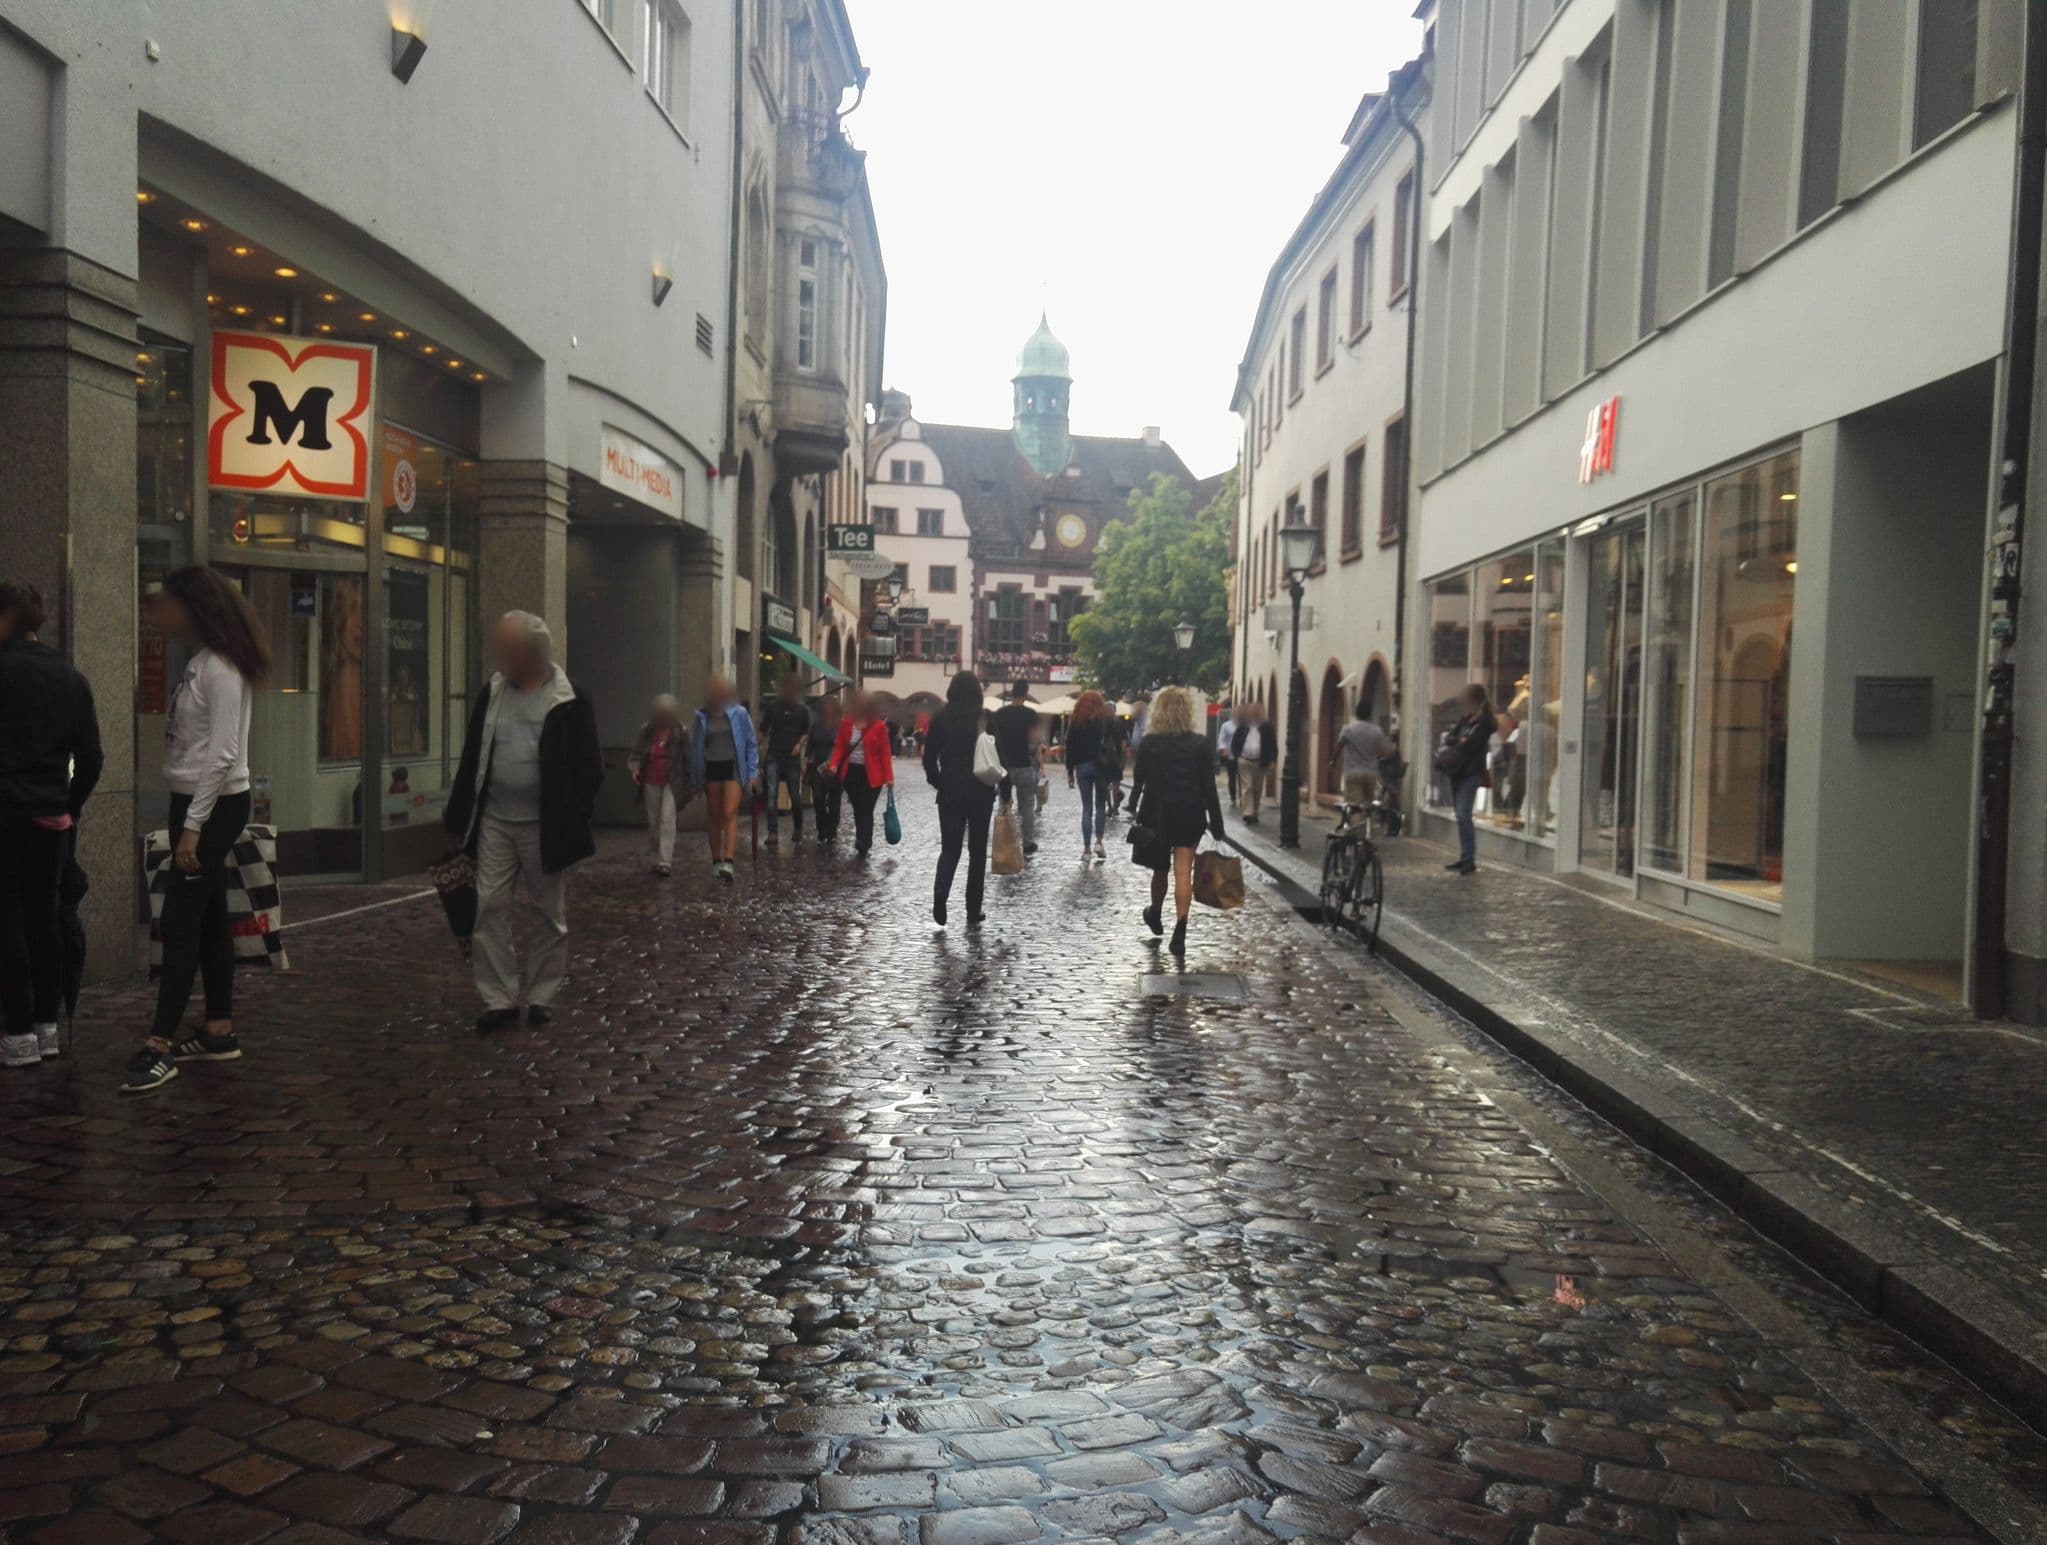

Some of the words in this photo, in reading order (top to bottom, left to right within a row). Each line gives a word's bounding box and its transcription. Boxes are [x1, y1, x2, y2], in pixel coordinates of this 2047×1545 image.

[246, 380, 334, 450] M
[1579, 394, 1620, 484] HM
[834, 527, 868, 547] Tee
[864, 660, 890, 670] Hotel
